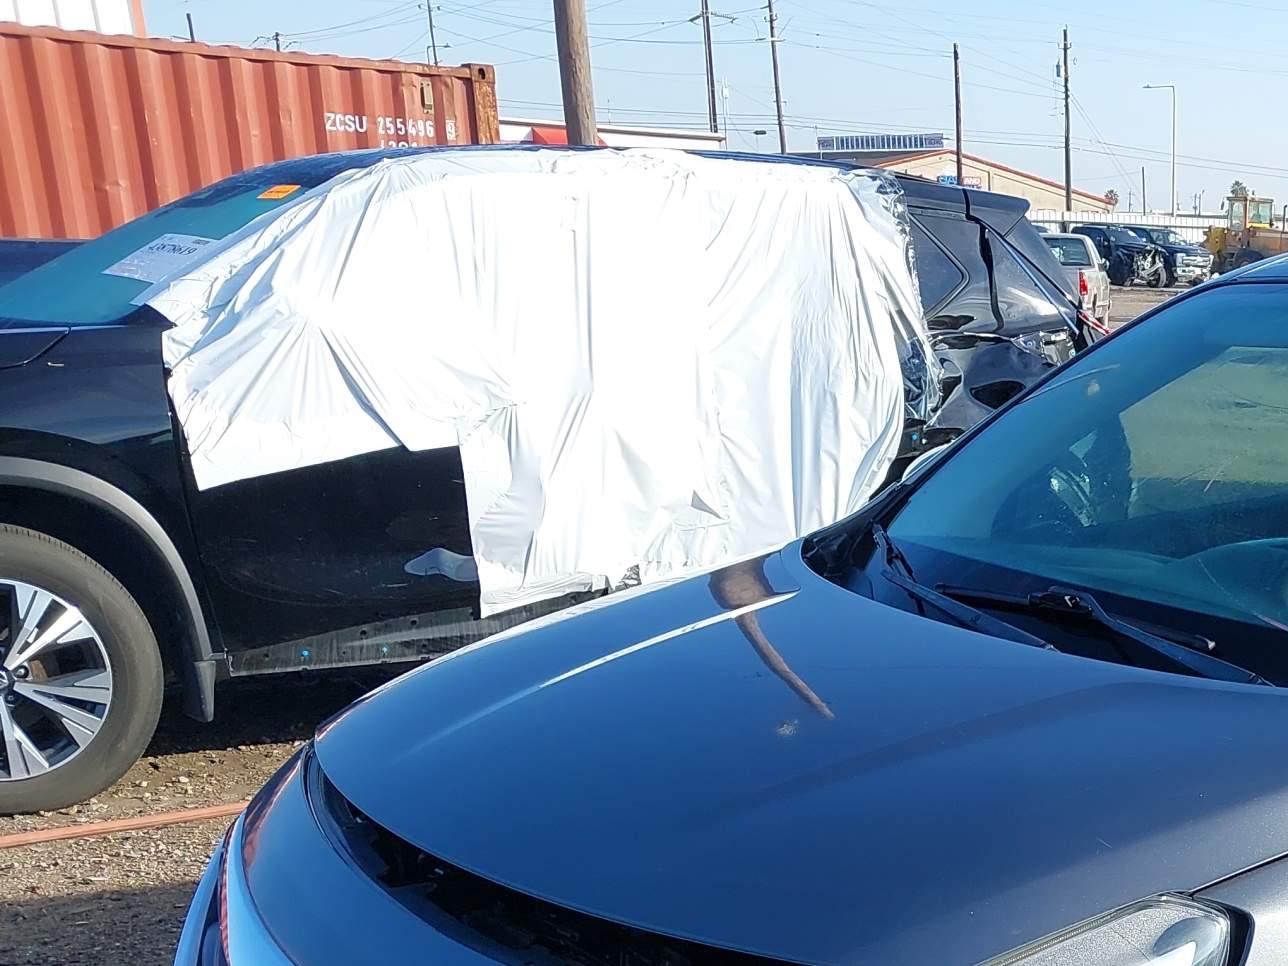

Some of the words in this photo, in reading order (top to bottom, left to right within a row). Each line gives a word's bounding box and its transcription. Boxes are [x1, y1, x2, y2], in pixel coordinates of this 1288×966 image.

[324, 113, 368, 133] ZCSU
[376, 116, 435, 138] 255496
[446, 121, 457, 140] 9
